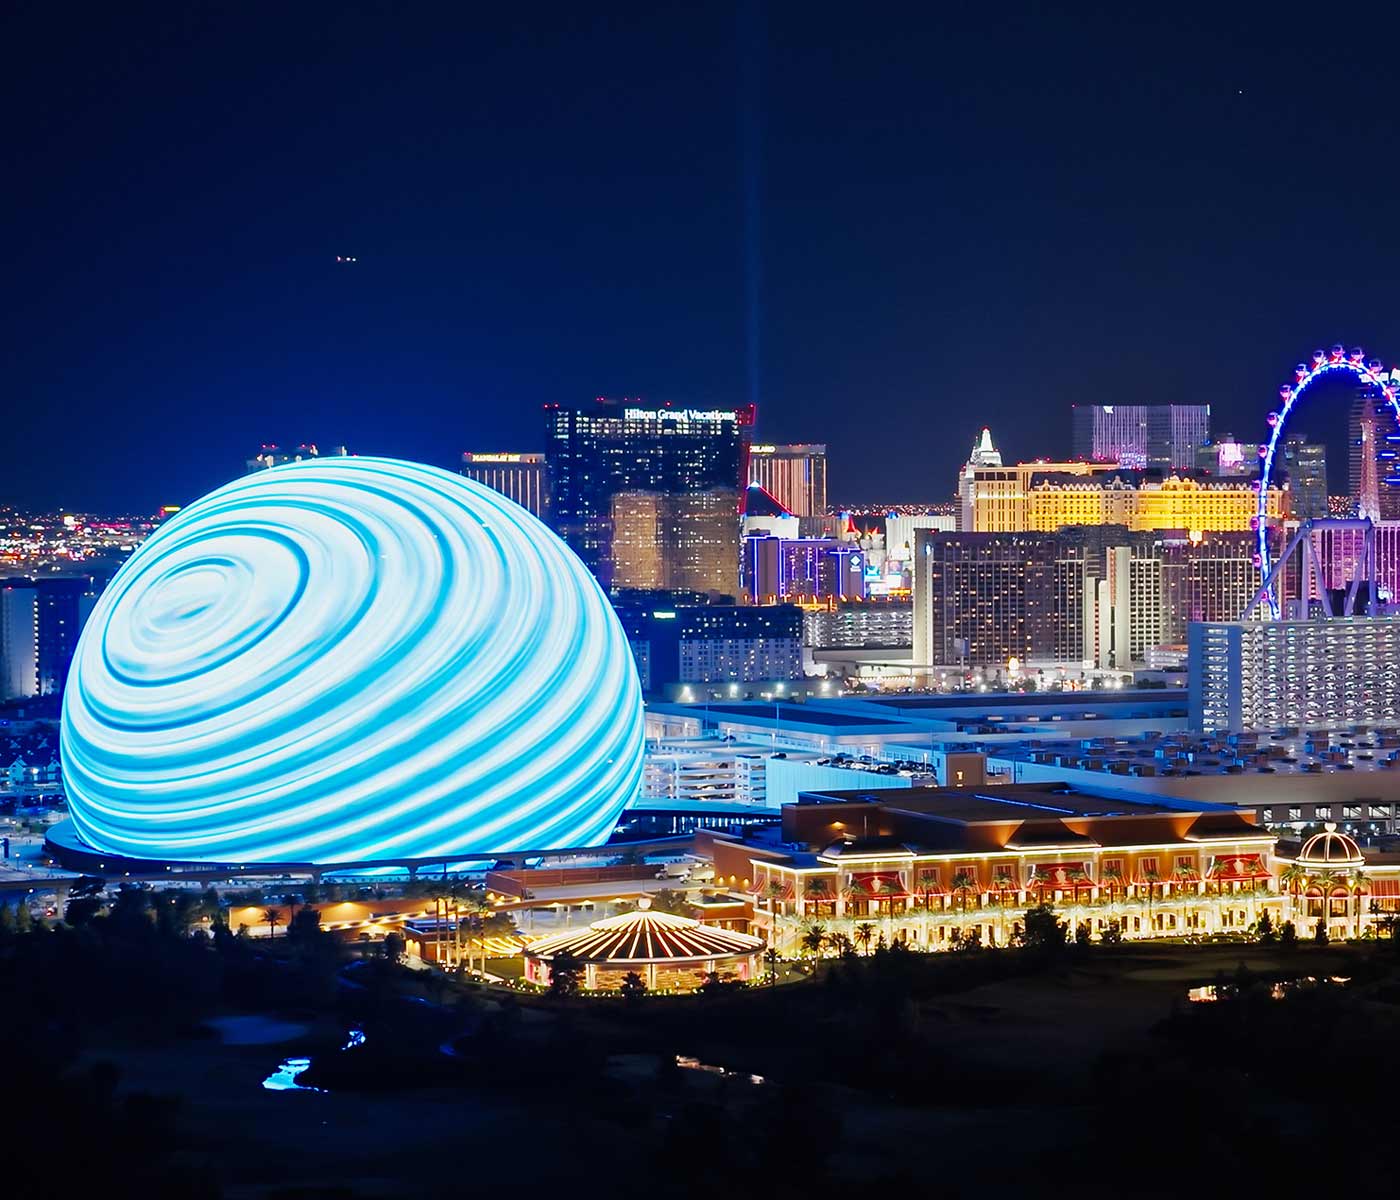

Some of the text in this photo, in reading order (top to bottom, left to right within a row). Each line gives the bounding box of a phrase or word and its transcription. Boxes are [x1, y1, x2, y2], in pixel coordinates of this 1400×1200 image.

[624, 408, 735, 421] Hilton Grand Vacations
